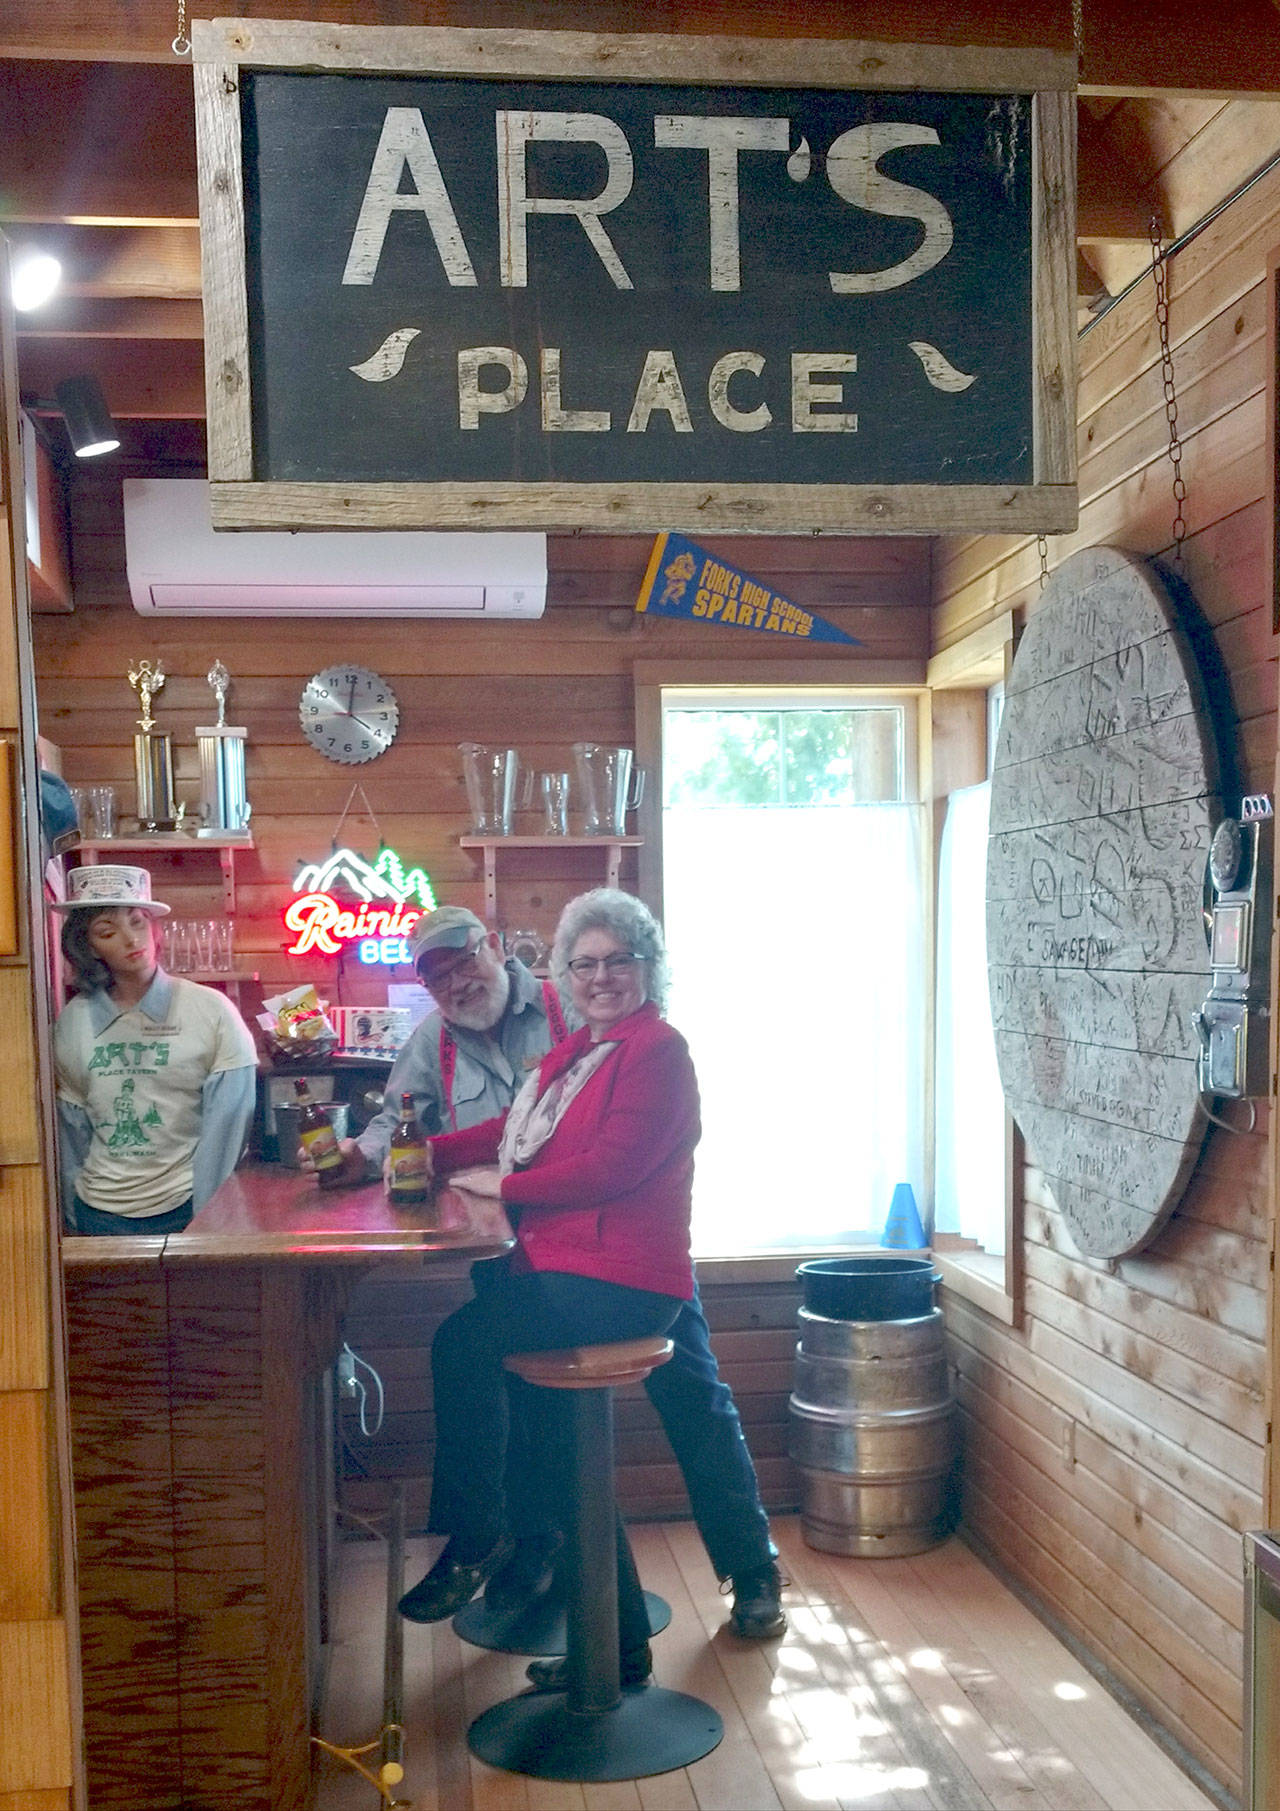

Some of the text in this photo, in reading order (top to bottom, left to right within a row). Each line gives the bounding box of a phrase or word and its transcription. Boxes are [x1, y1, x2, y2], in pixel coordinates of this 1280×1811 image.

[341, 106, 954, 294] ART'S
[457, 346, 859, 433] PLACE
[699, 559, 814, 627] FORKS HIGH SCHOOL
[692, 589, 813, 636] SPARTANS
[329, 678, 339, 687] 11
[344, 674, 358, 684] 12
[315, 689, 329, 698] 10
[376, 694, 385, 703] 2
[310, 706, 319, 716] 9
[380, 711, 388, 721] 3
[314, 724, 323, 733] 8
[373, 728, 382, 737] 4
[327, 738, 336, 747] 7
[343, 743, 353, 752] 6
[361, 740, 370, 749] 5
[283, 892, 426, 956] Rainie
[358, 938, 414, 965] BEE
[87, 1041, 170, 1072] ART'S
